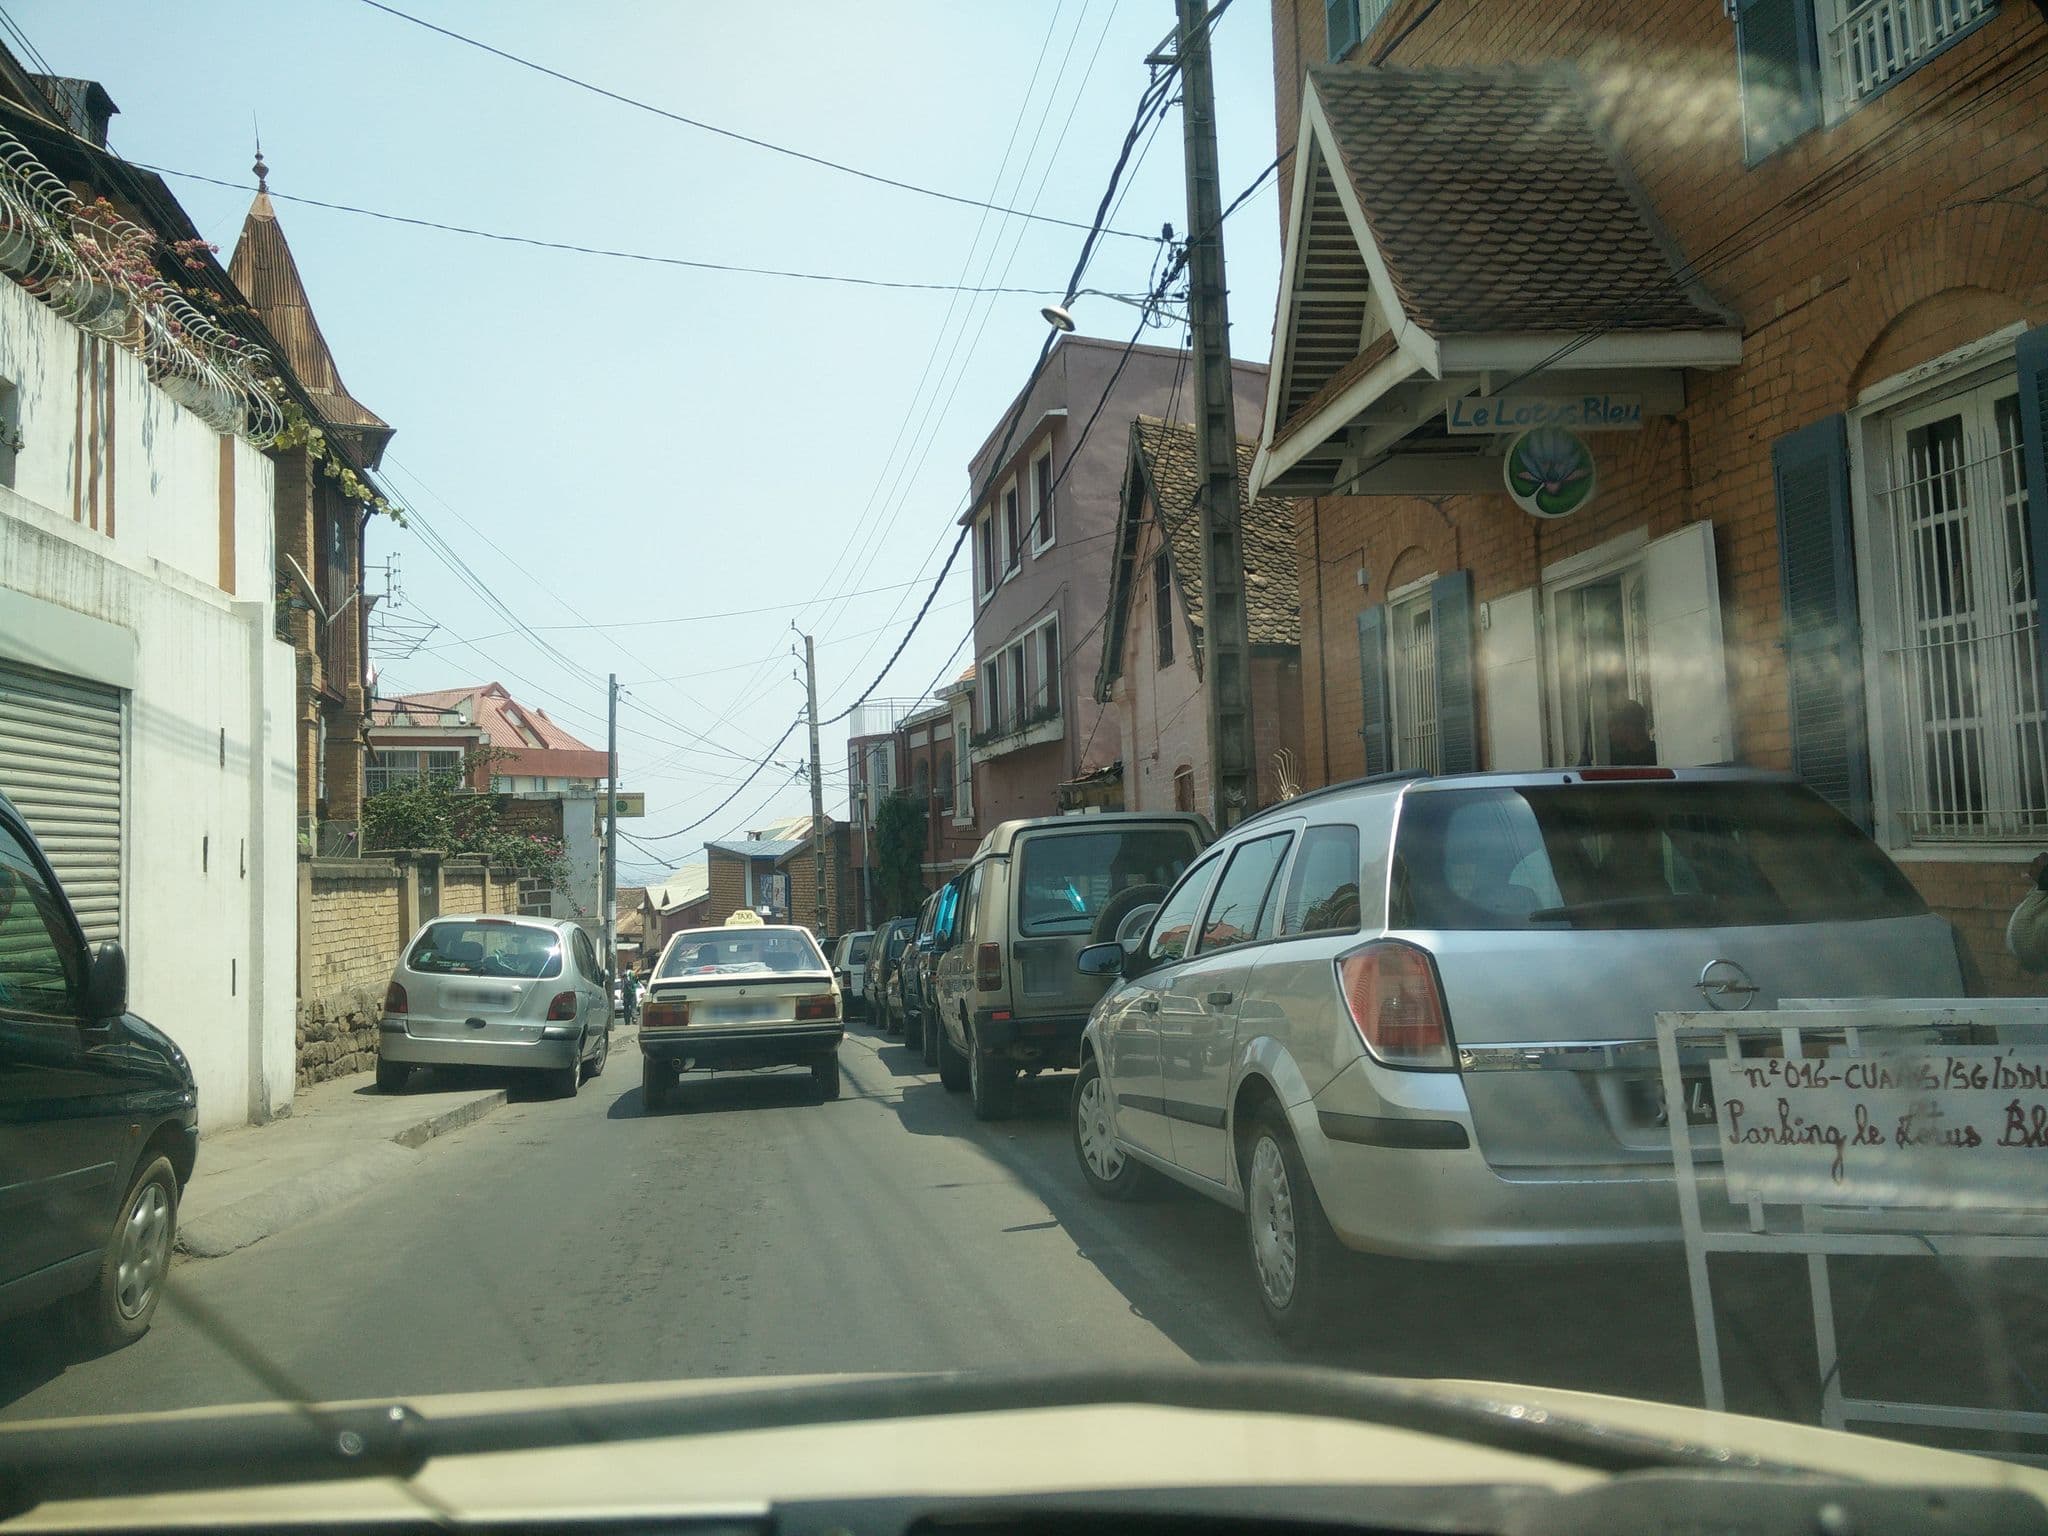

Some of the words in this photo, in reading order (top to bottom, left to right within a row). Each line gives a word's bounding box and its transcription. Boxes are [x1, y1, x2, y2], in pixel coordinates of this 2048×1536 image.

[1452, 399, 1488, 427] Le
[1583, 395, 1641, 425] Bleu
[736, 912, 753, 920] TAXI
[1724, 1098, 1848, 1185] Parking
[1852, 1103, 1886, 1146] le
